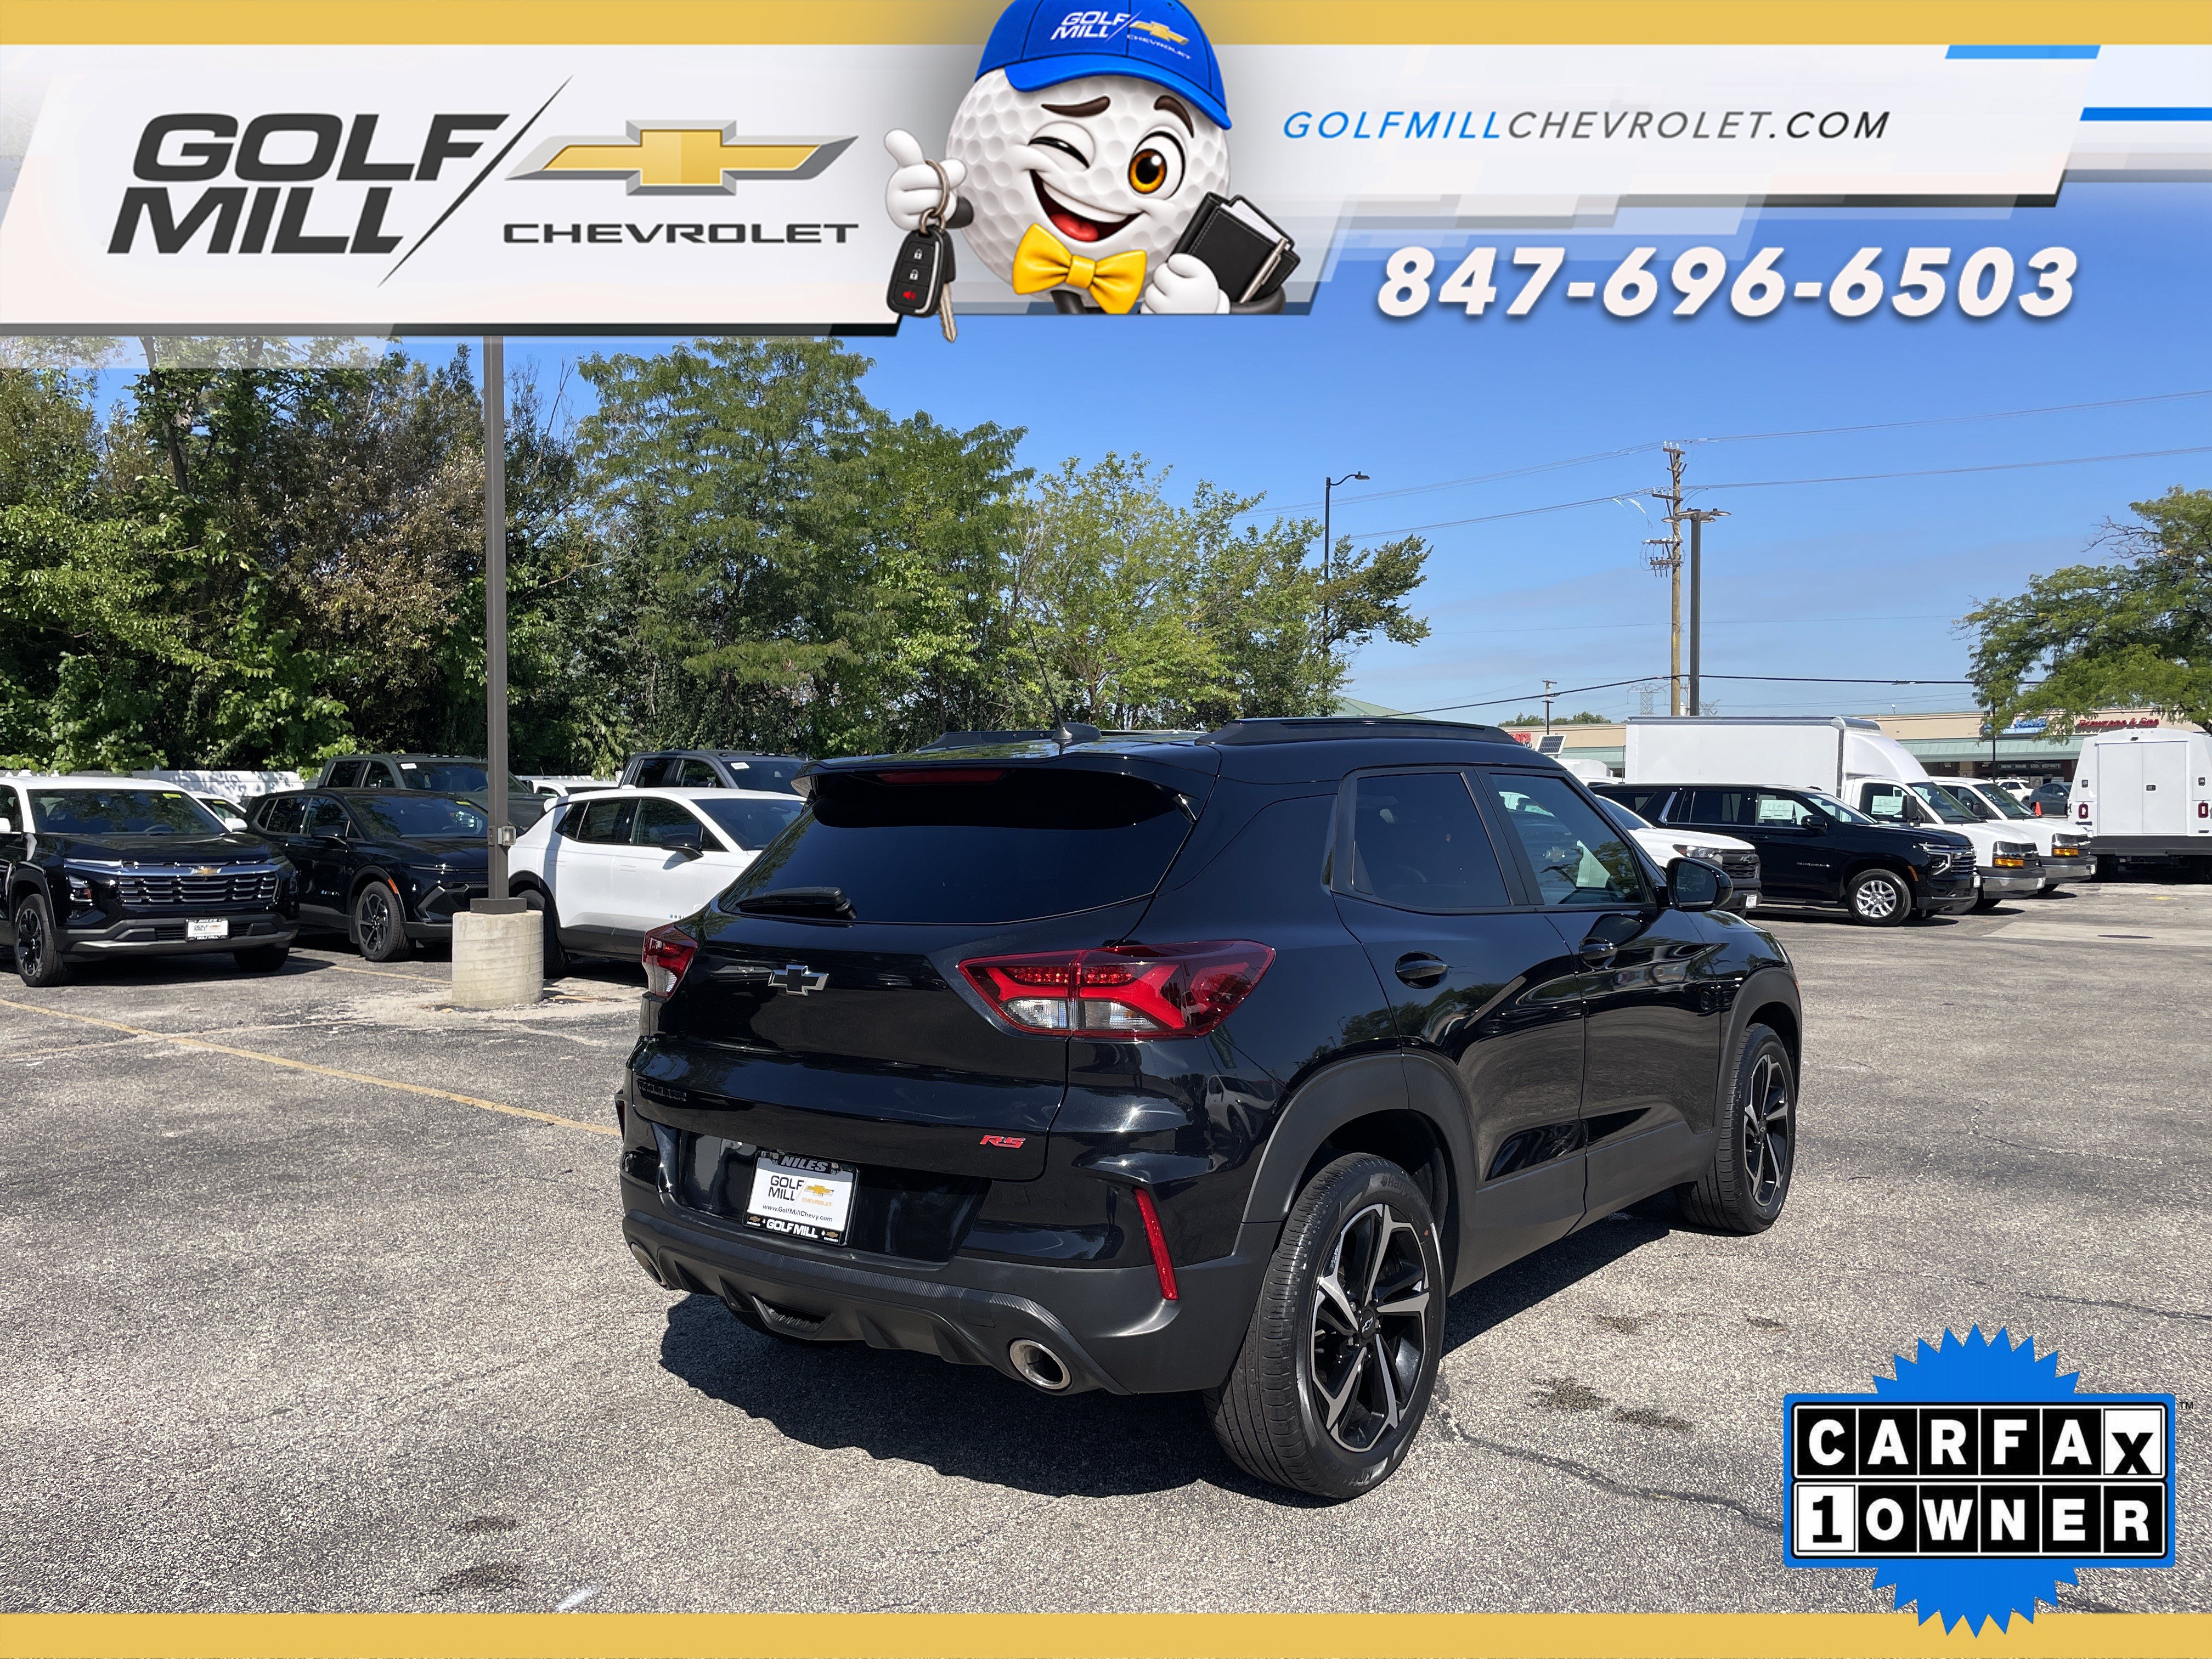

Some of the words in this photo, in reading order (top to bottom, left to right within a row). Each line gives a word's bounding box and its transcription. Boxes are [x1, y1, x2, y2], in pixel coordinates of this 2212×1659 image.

[979, 1135, 1026, 1148] RS
[781, 1156, 828, 1172] NILES
[770, 1175, 804, 1190] GOLF
[768, 1186, 795, 1201] MILL
[763, 1204, 833, 1222] www.GolfMillChevy.com
[766, 1218, 794, 1233] GOLF
[793, 1224, 818, 1239] MILL
